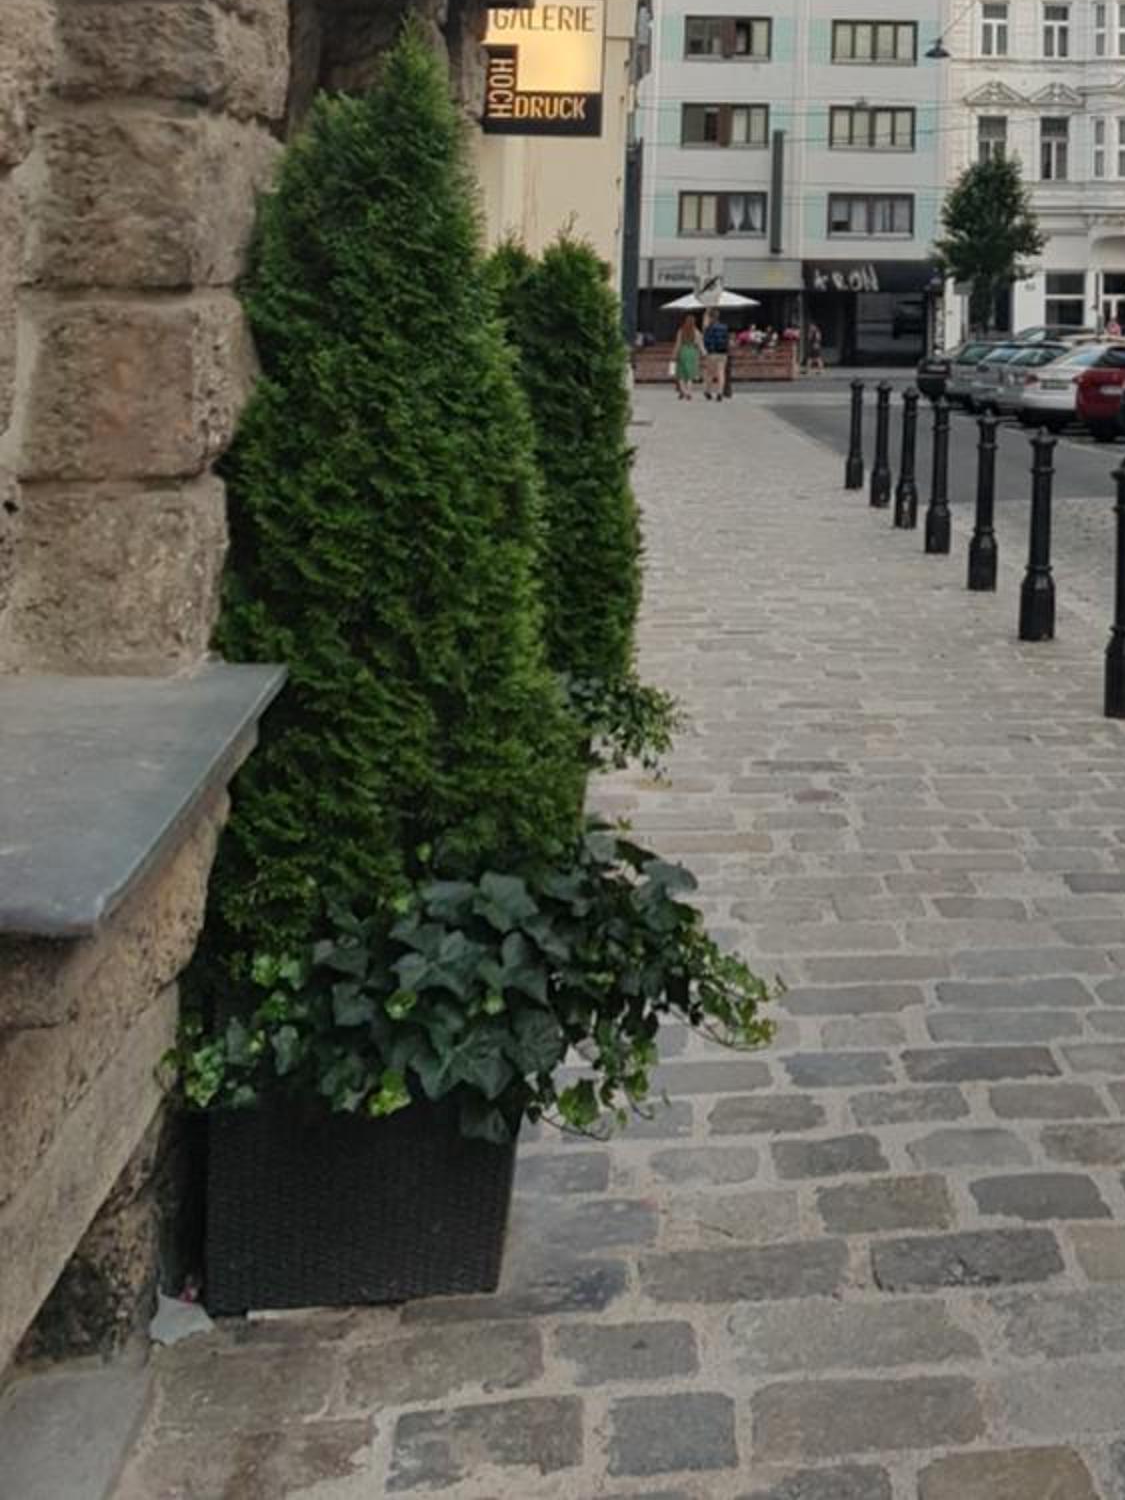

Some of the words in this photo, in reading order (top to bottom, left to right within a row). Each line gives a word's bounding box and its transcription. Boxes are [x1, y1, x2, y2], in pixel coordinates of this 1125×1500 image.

[494, 5, 595, 32] GALERIE
[488, 58, 514, 118] HOCH
[514, 95, 586, 119] DRUCK
